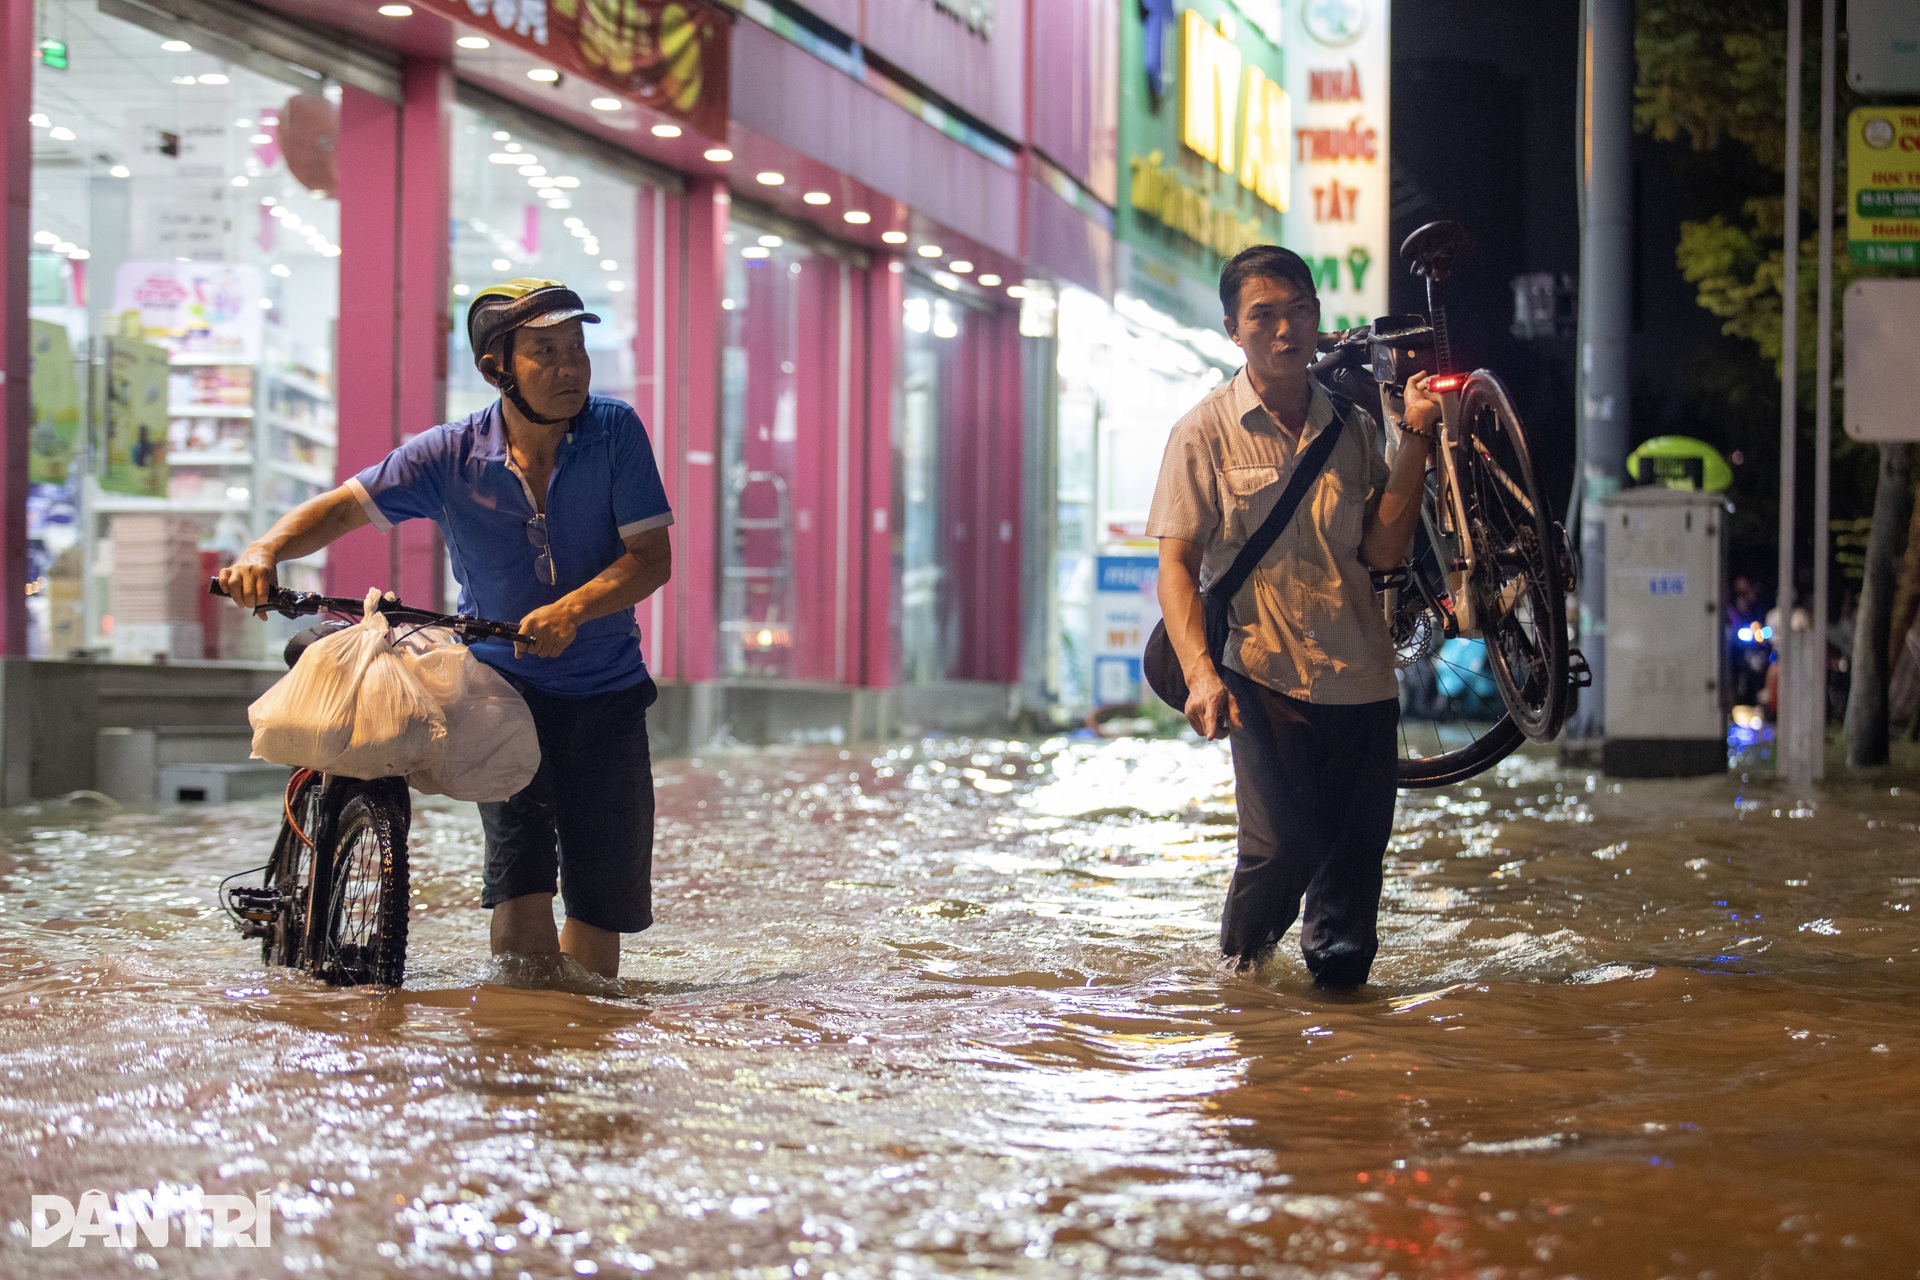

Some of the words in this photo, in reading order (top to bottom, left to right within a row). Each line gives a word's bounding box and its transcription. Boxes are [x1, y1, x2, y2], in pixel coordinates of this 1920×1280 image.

[1307, 61, 1363, 104] NHÀ
[1296, 117, 1376, 163] THUỐC
[1312, 178, 1358, 222] TÂY
